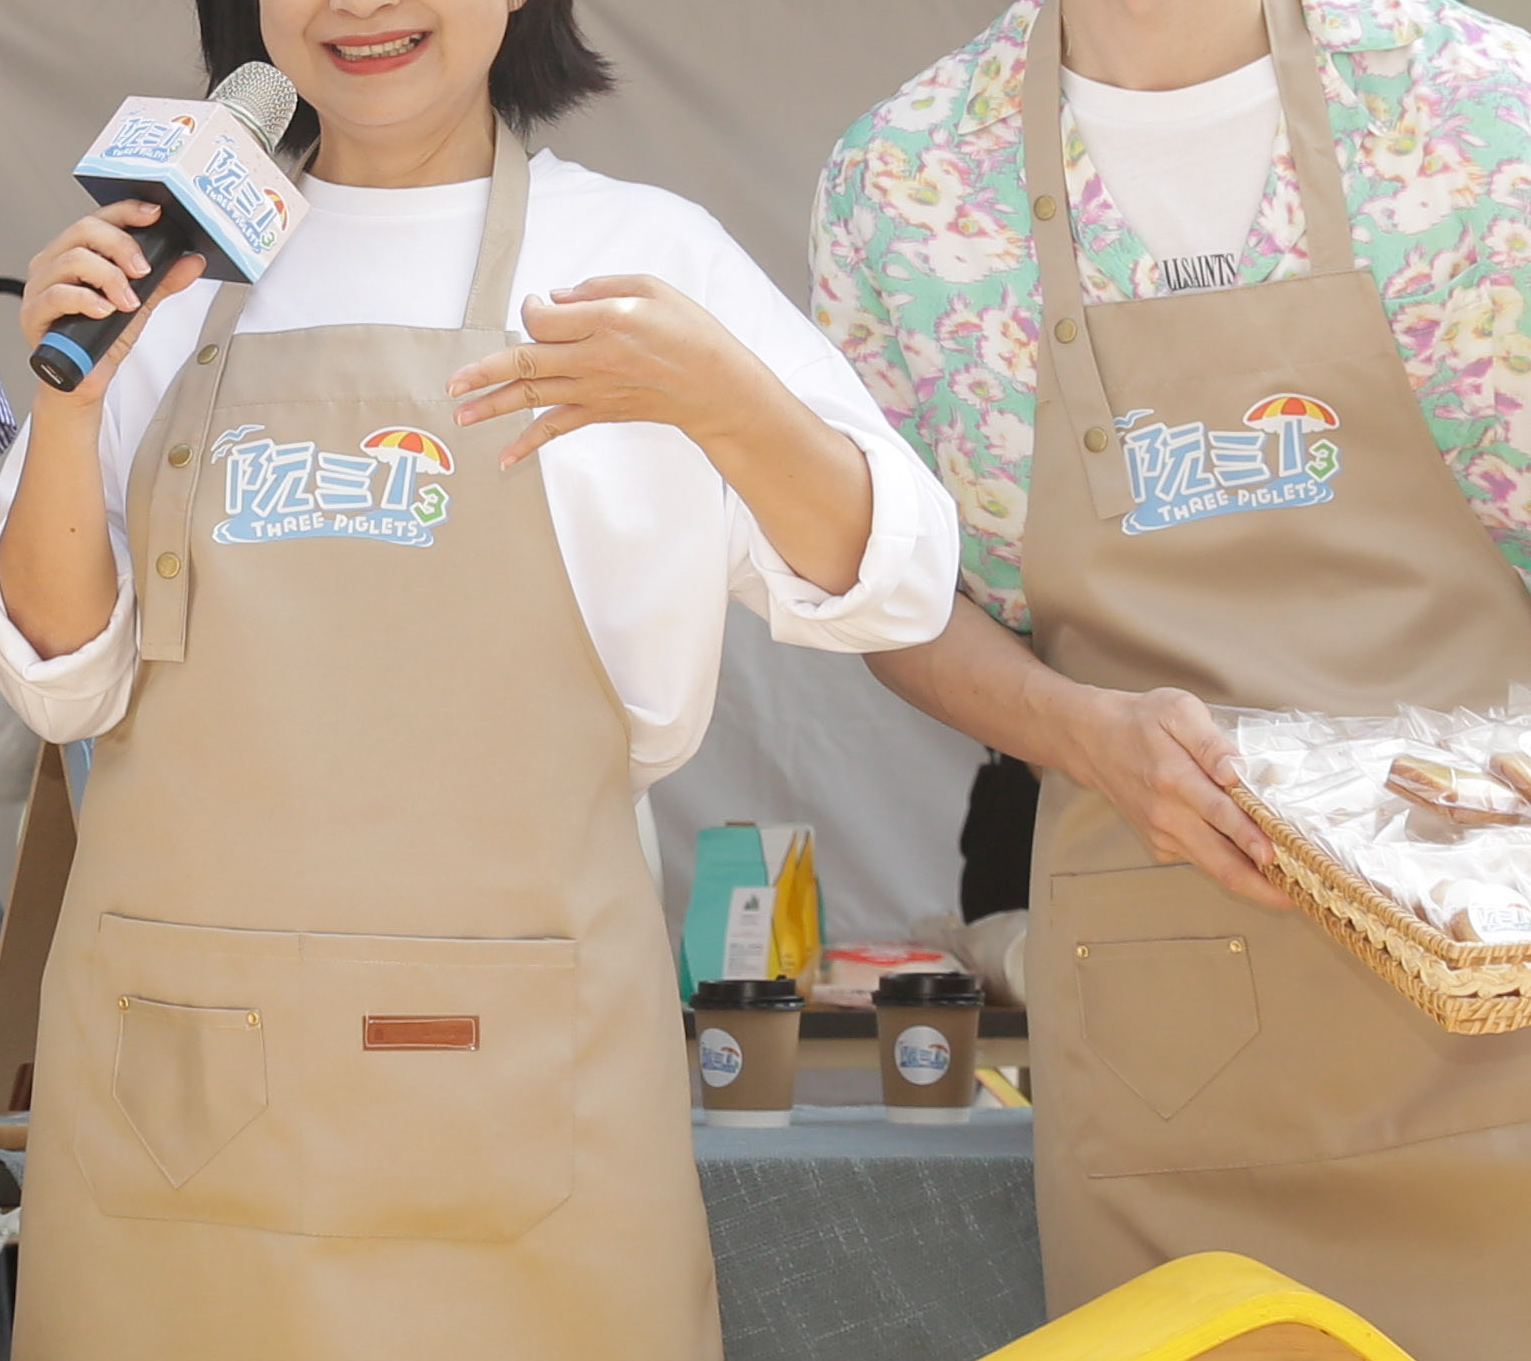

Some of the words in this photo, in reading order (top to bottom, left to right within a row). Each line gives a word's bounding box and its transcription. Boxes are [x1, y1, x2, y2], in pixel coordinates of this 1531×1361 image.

[1161, 253, 1236, 291] LLSAINTS
[1306, 442, 1336, 477] 3
[412, 486, 447, 522] 3
[1159, 493, 1229, 523] THREE
[1237, 480, 1318, 507] PIGLETS
[251, 512, 324, 538] THREE
[333, 514, 419, 538] PIGLETS
